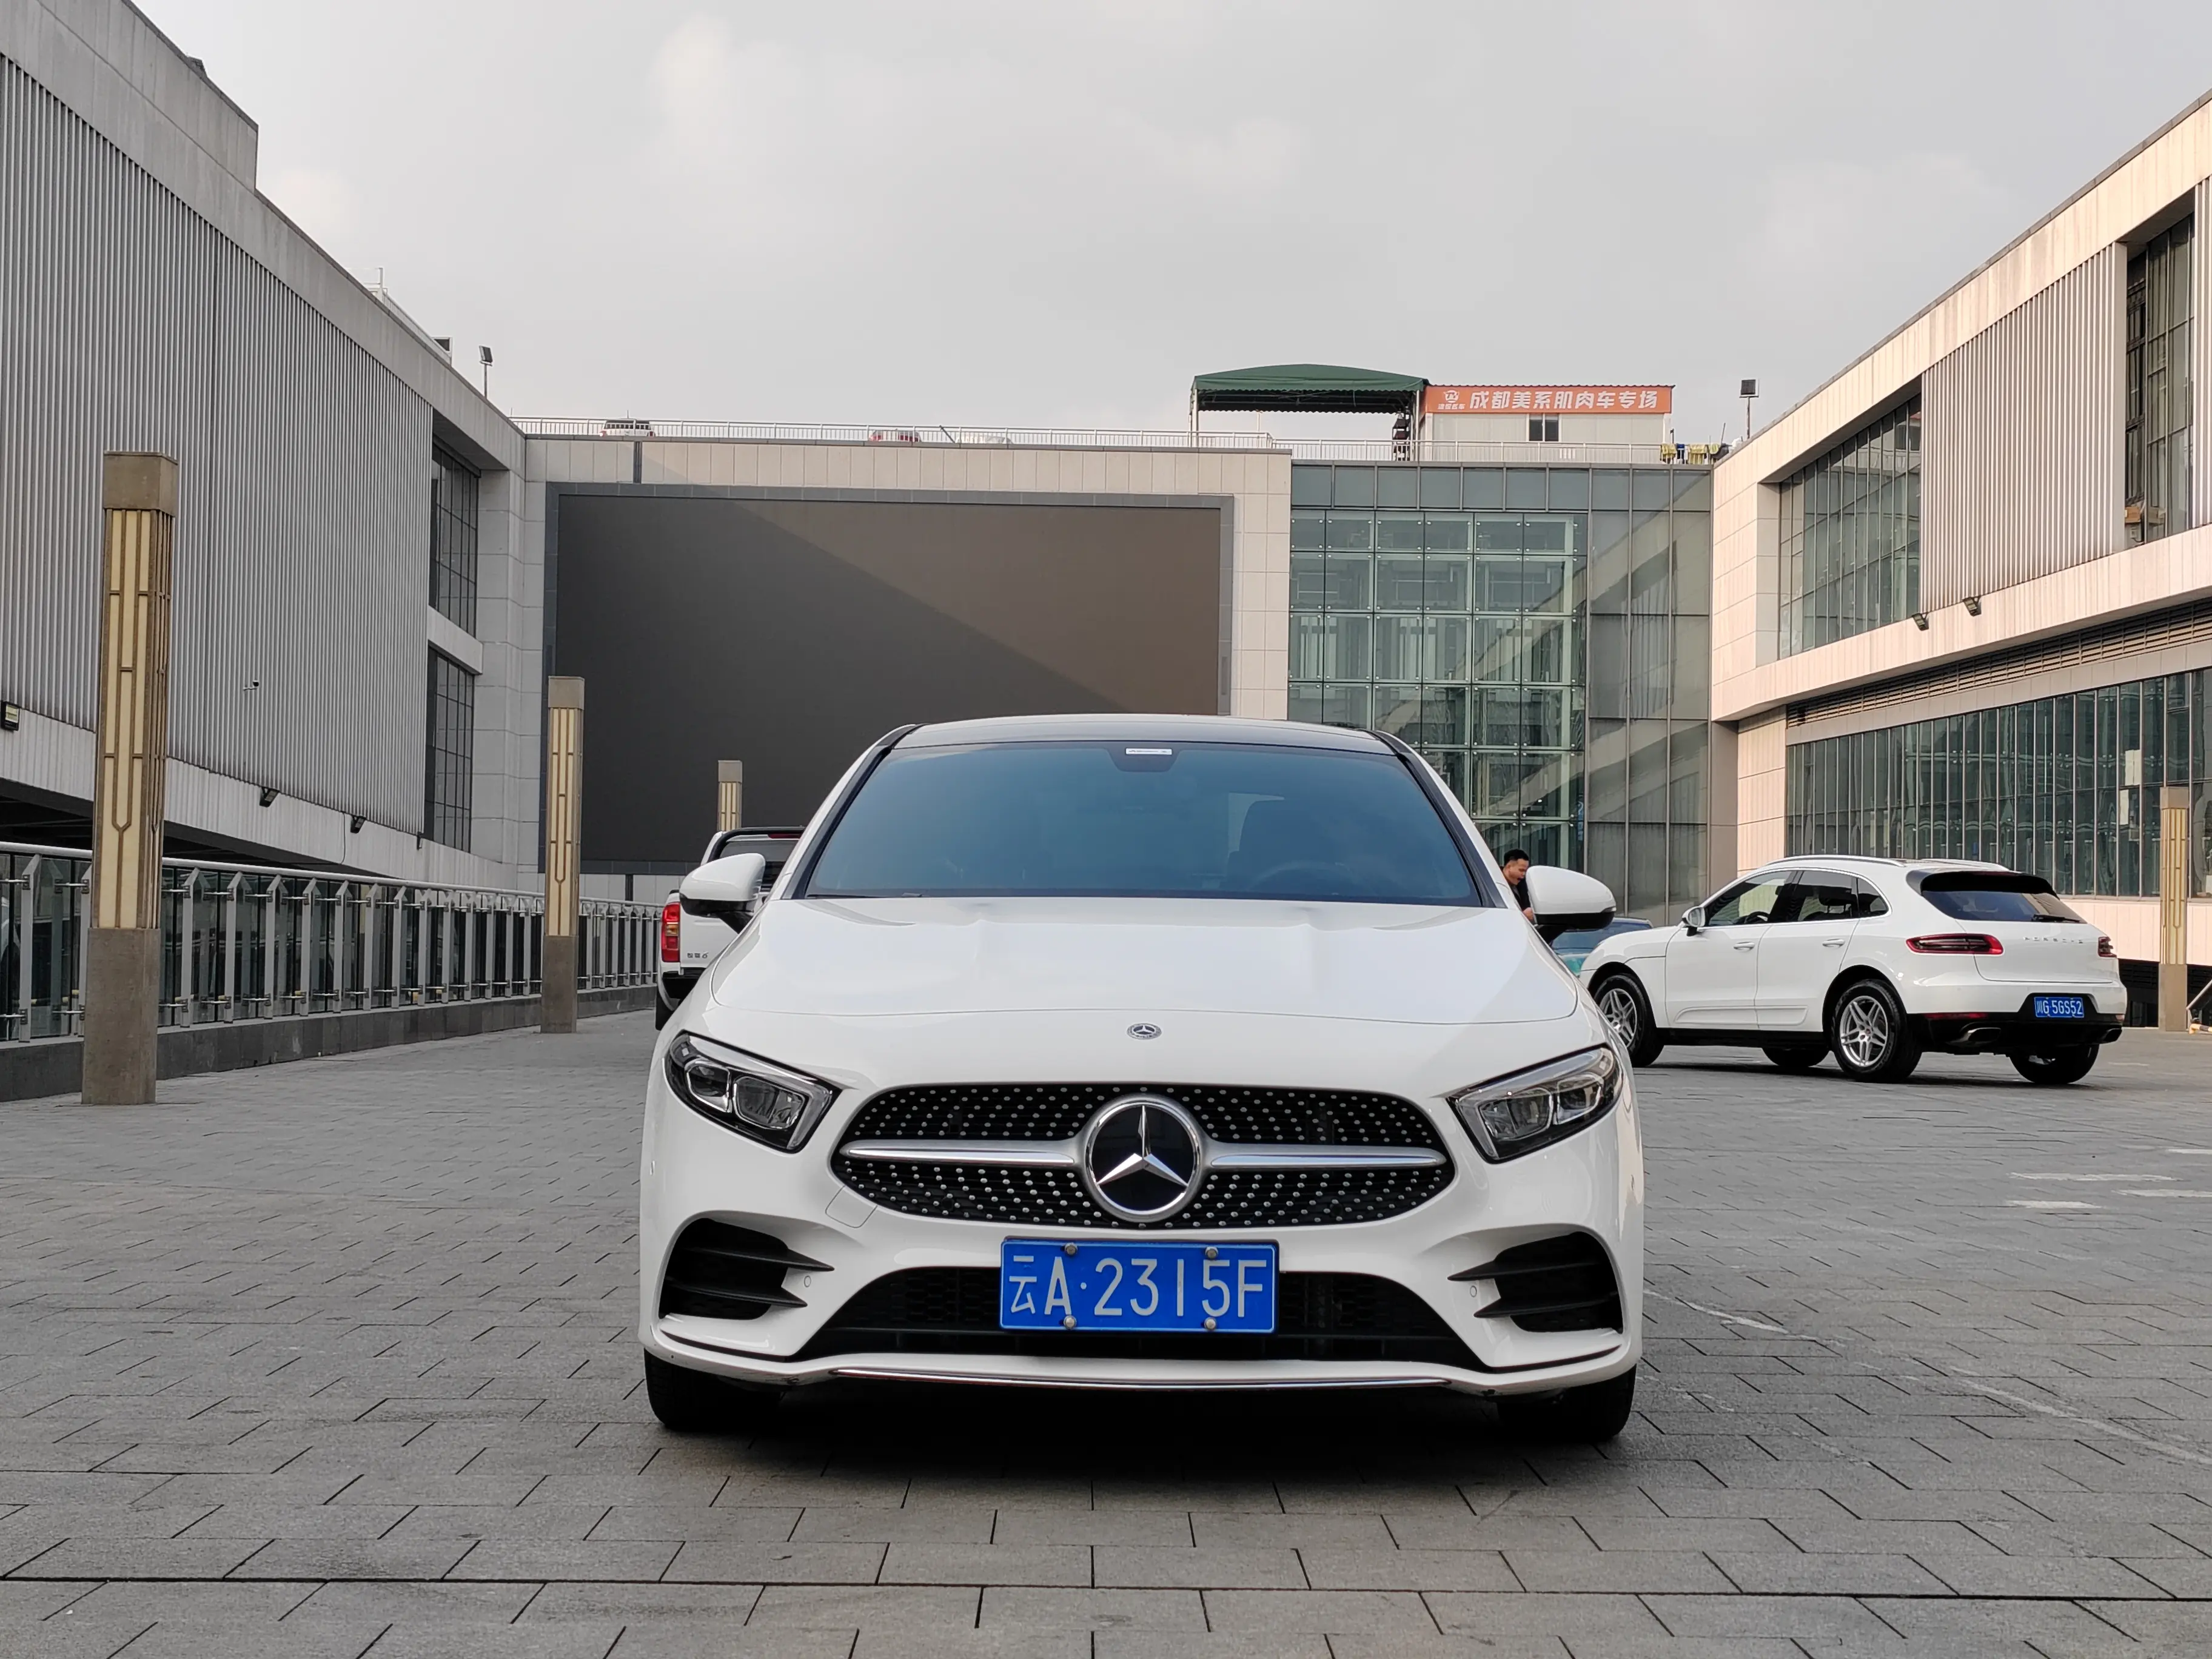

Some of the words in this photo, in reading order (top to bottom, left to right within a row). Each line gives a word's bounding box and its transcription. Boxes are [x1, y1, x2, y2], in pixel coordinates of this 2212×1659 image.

[1469, 390, 1658, 409] 成都美系肌肉车专场
[1009, 1255, 1267, 1318] 云A·2315F
